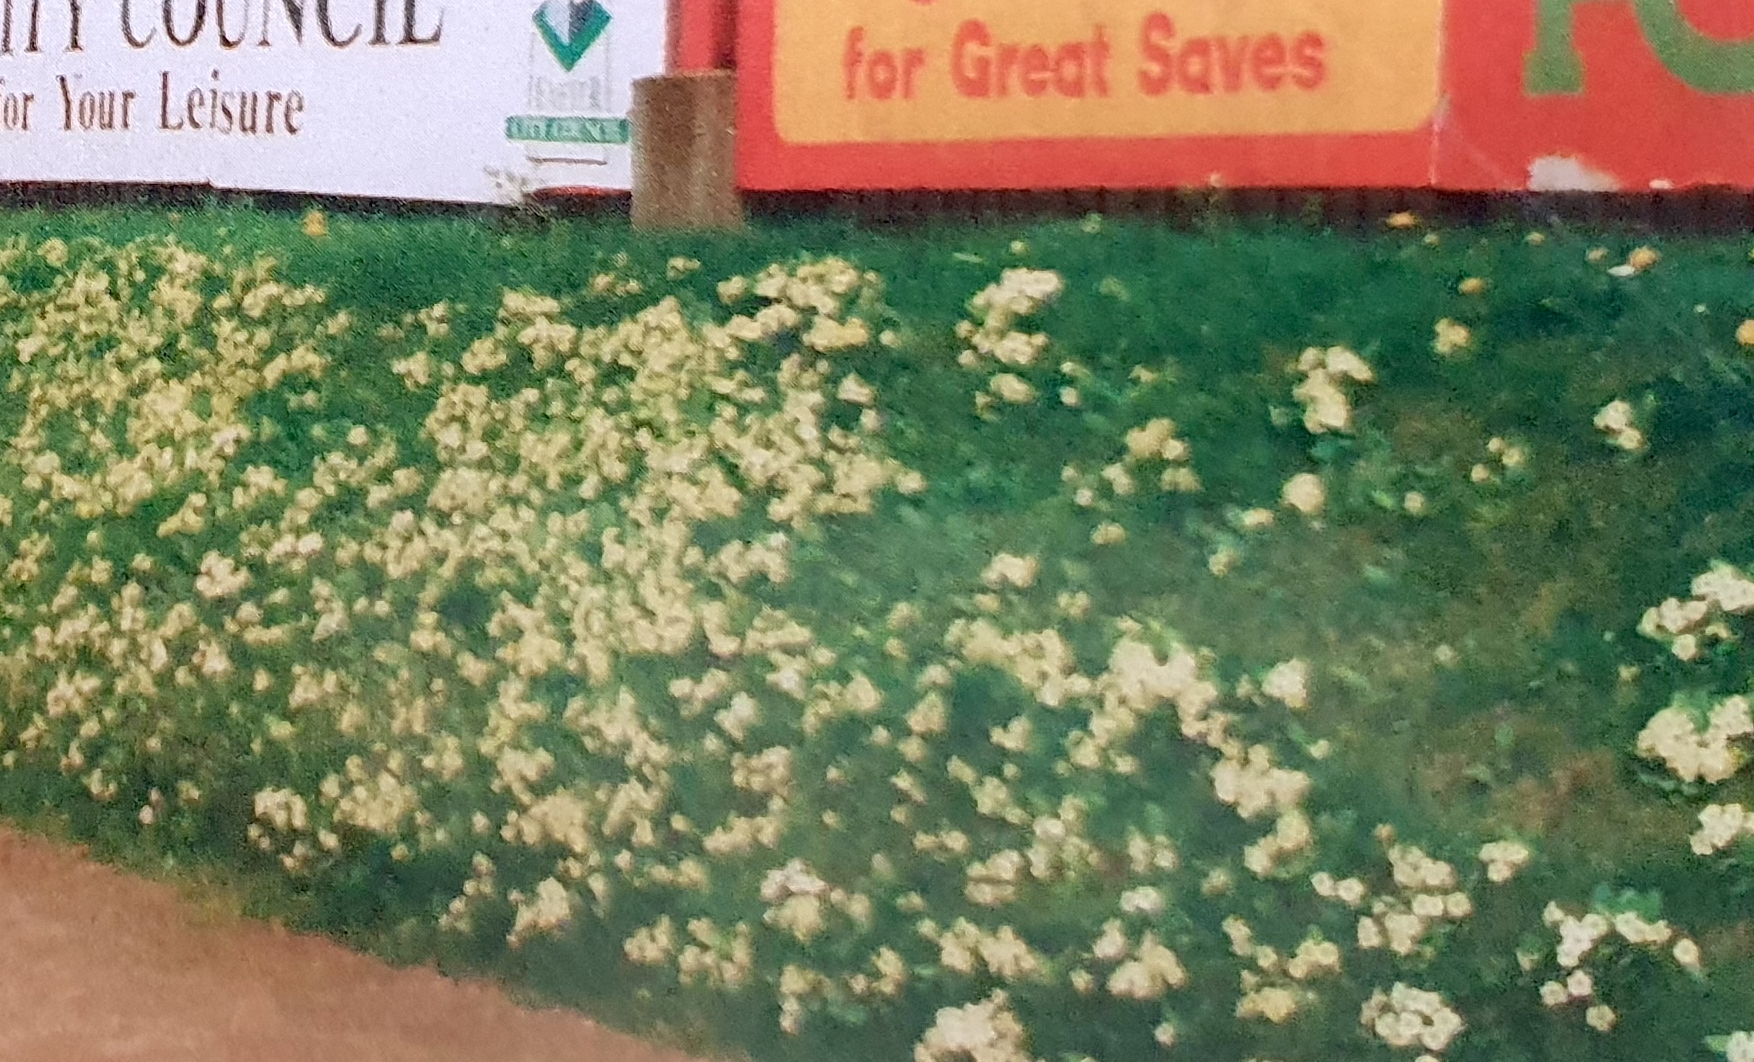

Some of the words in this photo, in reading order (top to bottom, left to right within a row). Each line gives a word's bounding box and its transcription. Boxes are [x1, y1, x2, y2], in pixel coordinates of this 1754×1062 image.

[843, 27, 926, 102] for
[950, 17, 1112, 100] Great
[1137, 12, 1329, 98] Saves
[57, 73, 137, 133] Your
[159, 69, 306, 137] Leisure
